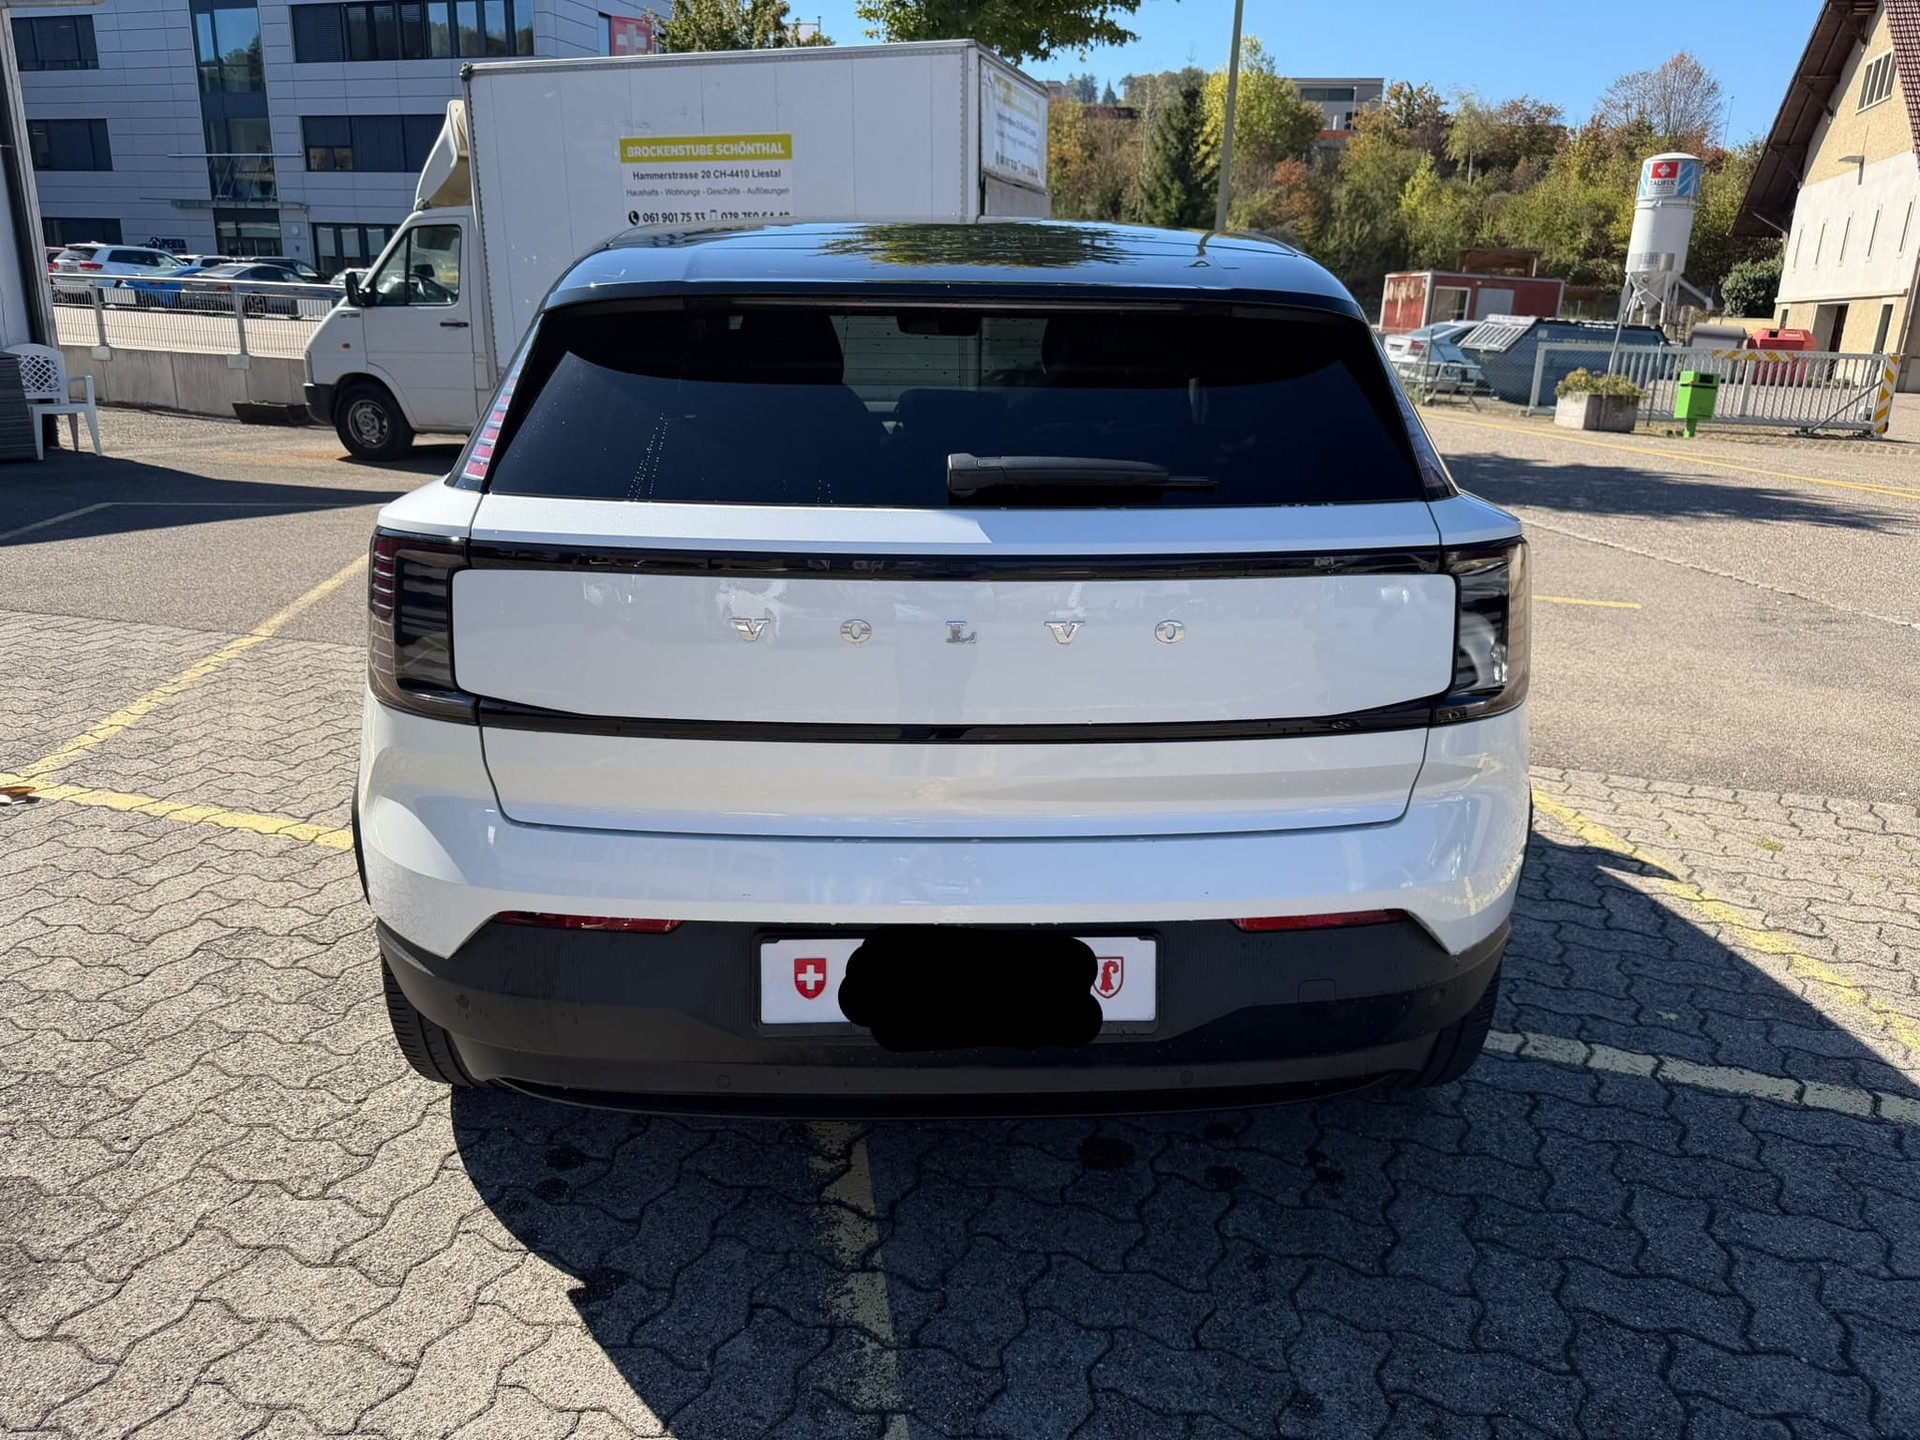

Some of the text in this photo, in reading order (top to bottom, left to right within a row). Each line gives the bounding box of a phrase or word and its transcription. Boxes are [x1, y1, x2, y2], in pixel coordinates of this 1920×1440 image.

[627, 141, 785, 158] BROCKENSTUBE SCHÖNTHAL
[632, 168, 782, 180] Hammerstrasse 20 CH-4410 Liestal
[626, 188, 659, 197] Haushalts
[664, 188, 700, 197] Wohnungs
[706, 187, 741, 196] Geschäfts
[747, 186, 790, 197] Auflösungen
[643, 212, 659, 223] 061
[661, 212, 678, 223] 901
[680, 212, 692, 223] 75
[730, 618, 1187, 645] VOLVO
